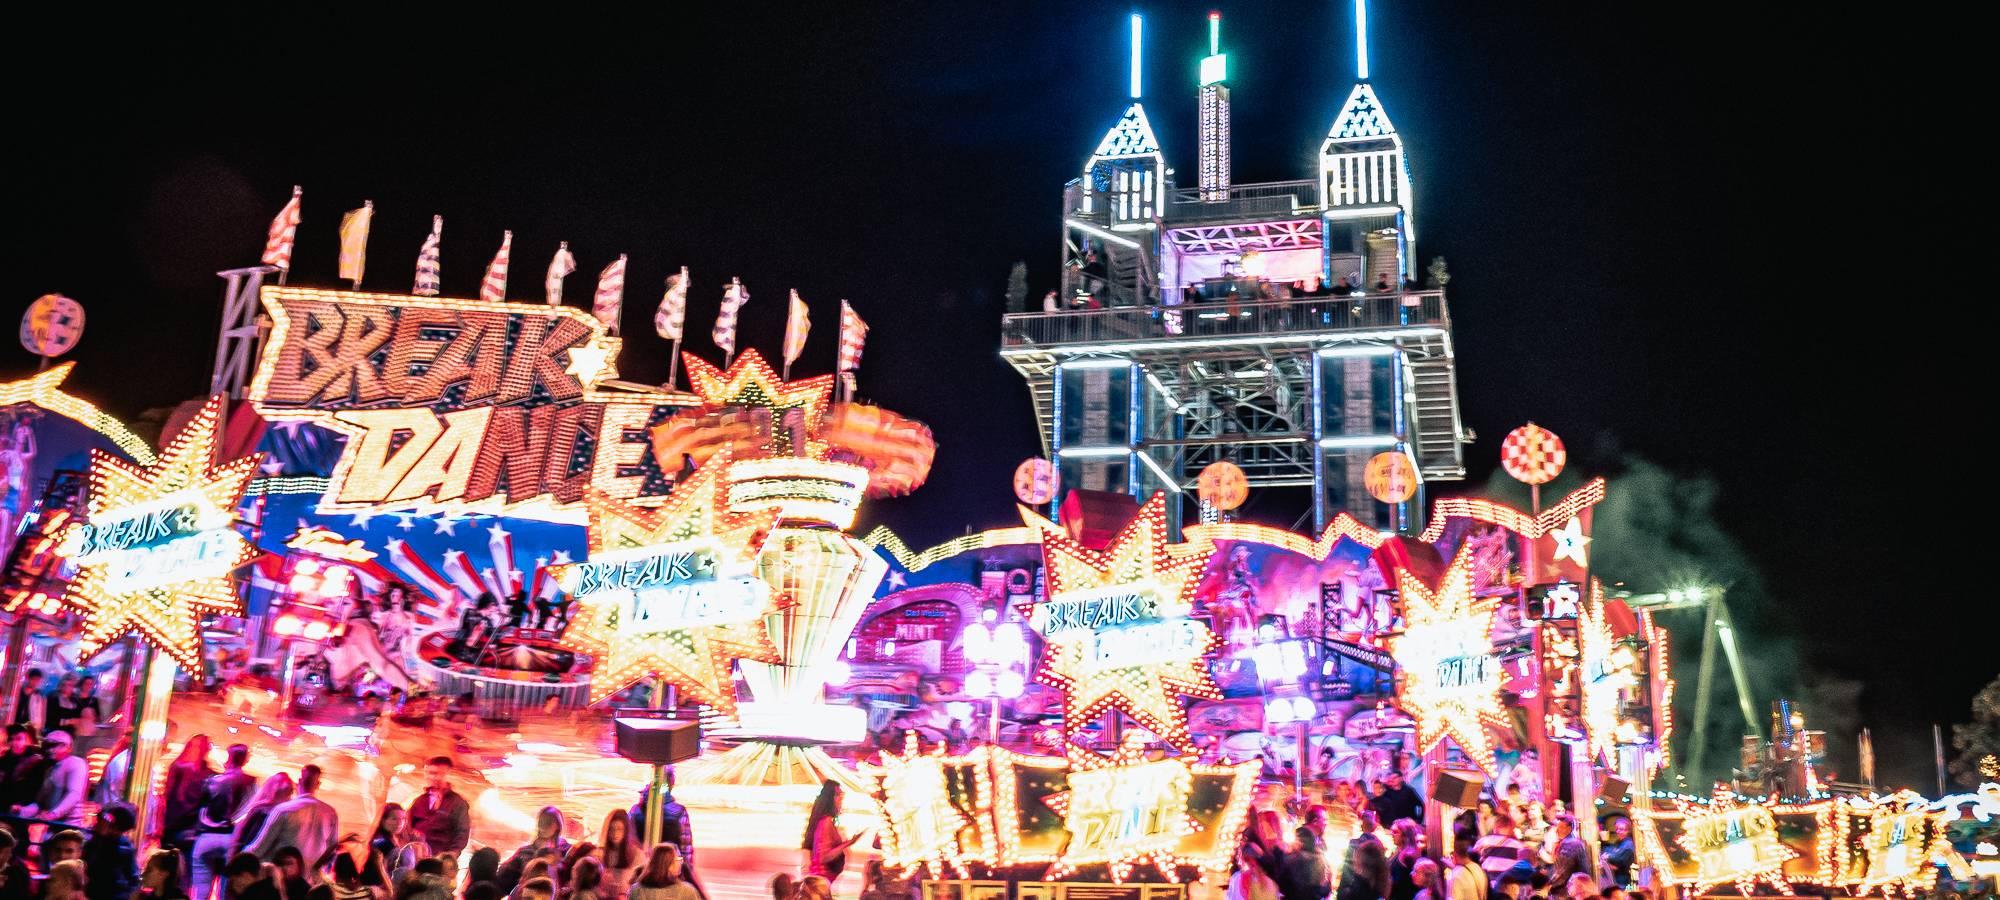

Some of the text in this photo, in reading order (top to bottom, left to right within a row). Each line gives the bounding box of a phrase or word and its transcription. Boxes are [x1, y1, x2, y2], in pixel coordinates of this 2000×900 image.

[264, 299, 594, 408] BREAK
[334, 403, 655, 505] DANCE
[78, 508, 177, 558] BREAK
[574, 551, 696, 598] BREAK
[1045, 594, 1141, 637] BREAK
